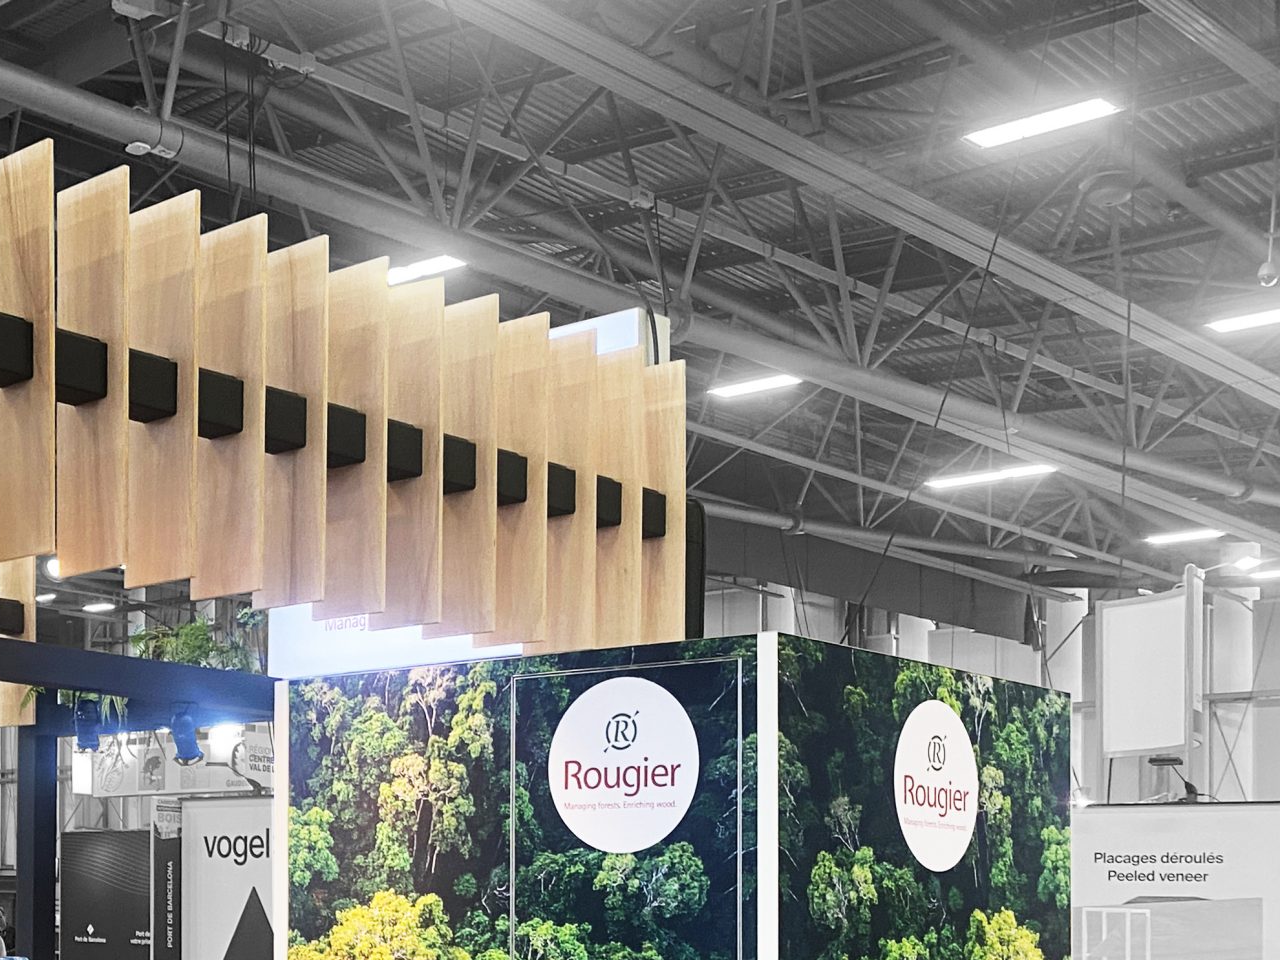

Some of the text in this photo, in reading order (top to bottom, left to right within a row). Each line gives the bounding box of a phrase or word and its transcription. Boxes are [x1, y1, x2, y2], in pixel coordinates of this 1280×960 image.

[324, 614, 367, 633] Manag
[249, 763, 261, 772] VAL
[564, 757, 681, 797] Rougier
[904, 774, 969, 817] Rougier
[564, 801, 597, 811] Managing
[623, 799, 654, 811] Enriching
[204, 828, 269, 865] vogel
[1094, 852, 1224, 866] Placages déroulés
[1108, 870, 1209, 882] Peeled veneer
[166, 912, 173, 924] DE
